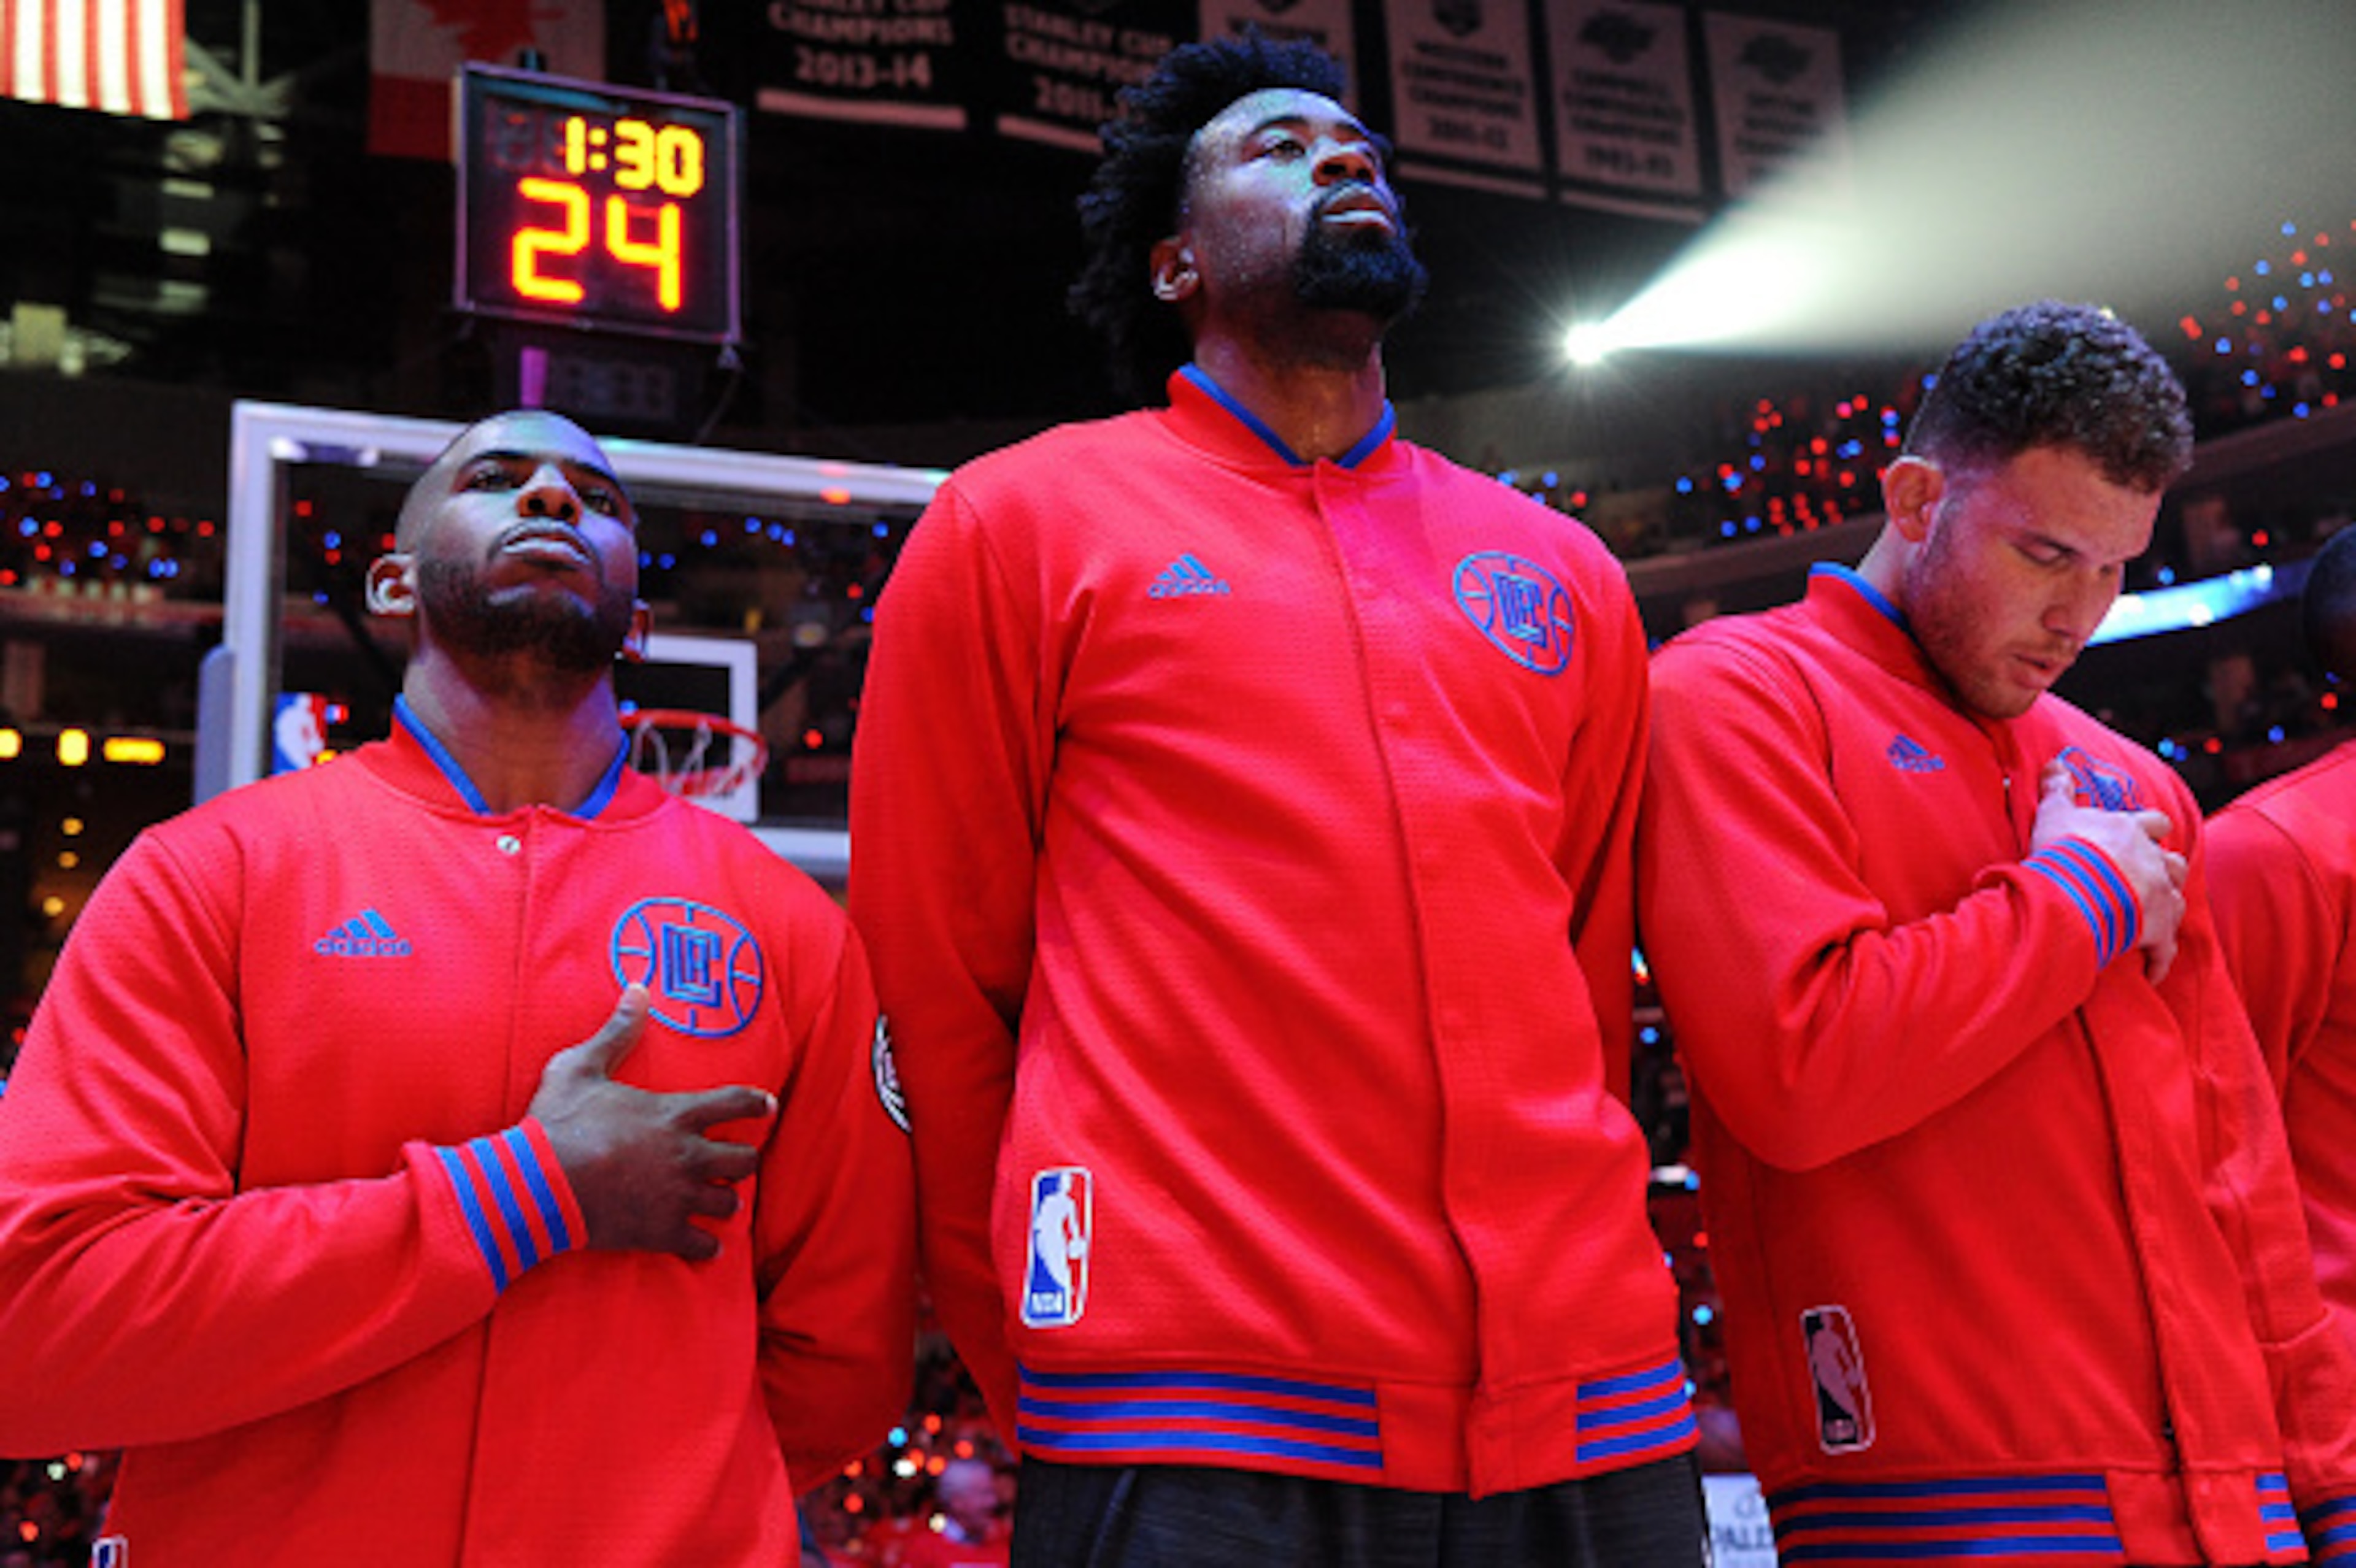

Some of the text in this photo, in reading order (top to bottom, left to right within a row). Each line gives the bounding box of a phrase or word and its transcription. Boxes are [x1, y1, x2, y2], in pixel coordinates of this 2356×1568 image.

[565, 115, 704, 198] 1:30
[512, 177, 682, 312] 24
[314, 936, 413, 958] adidas
